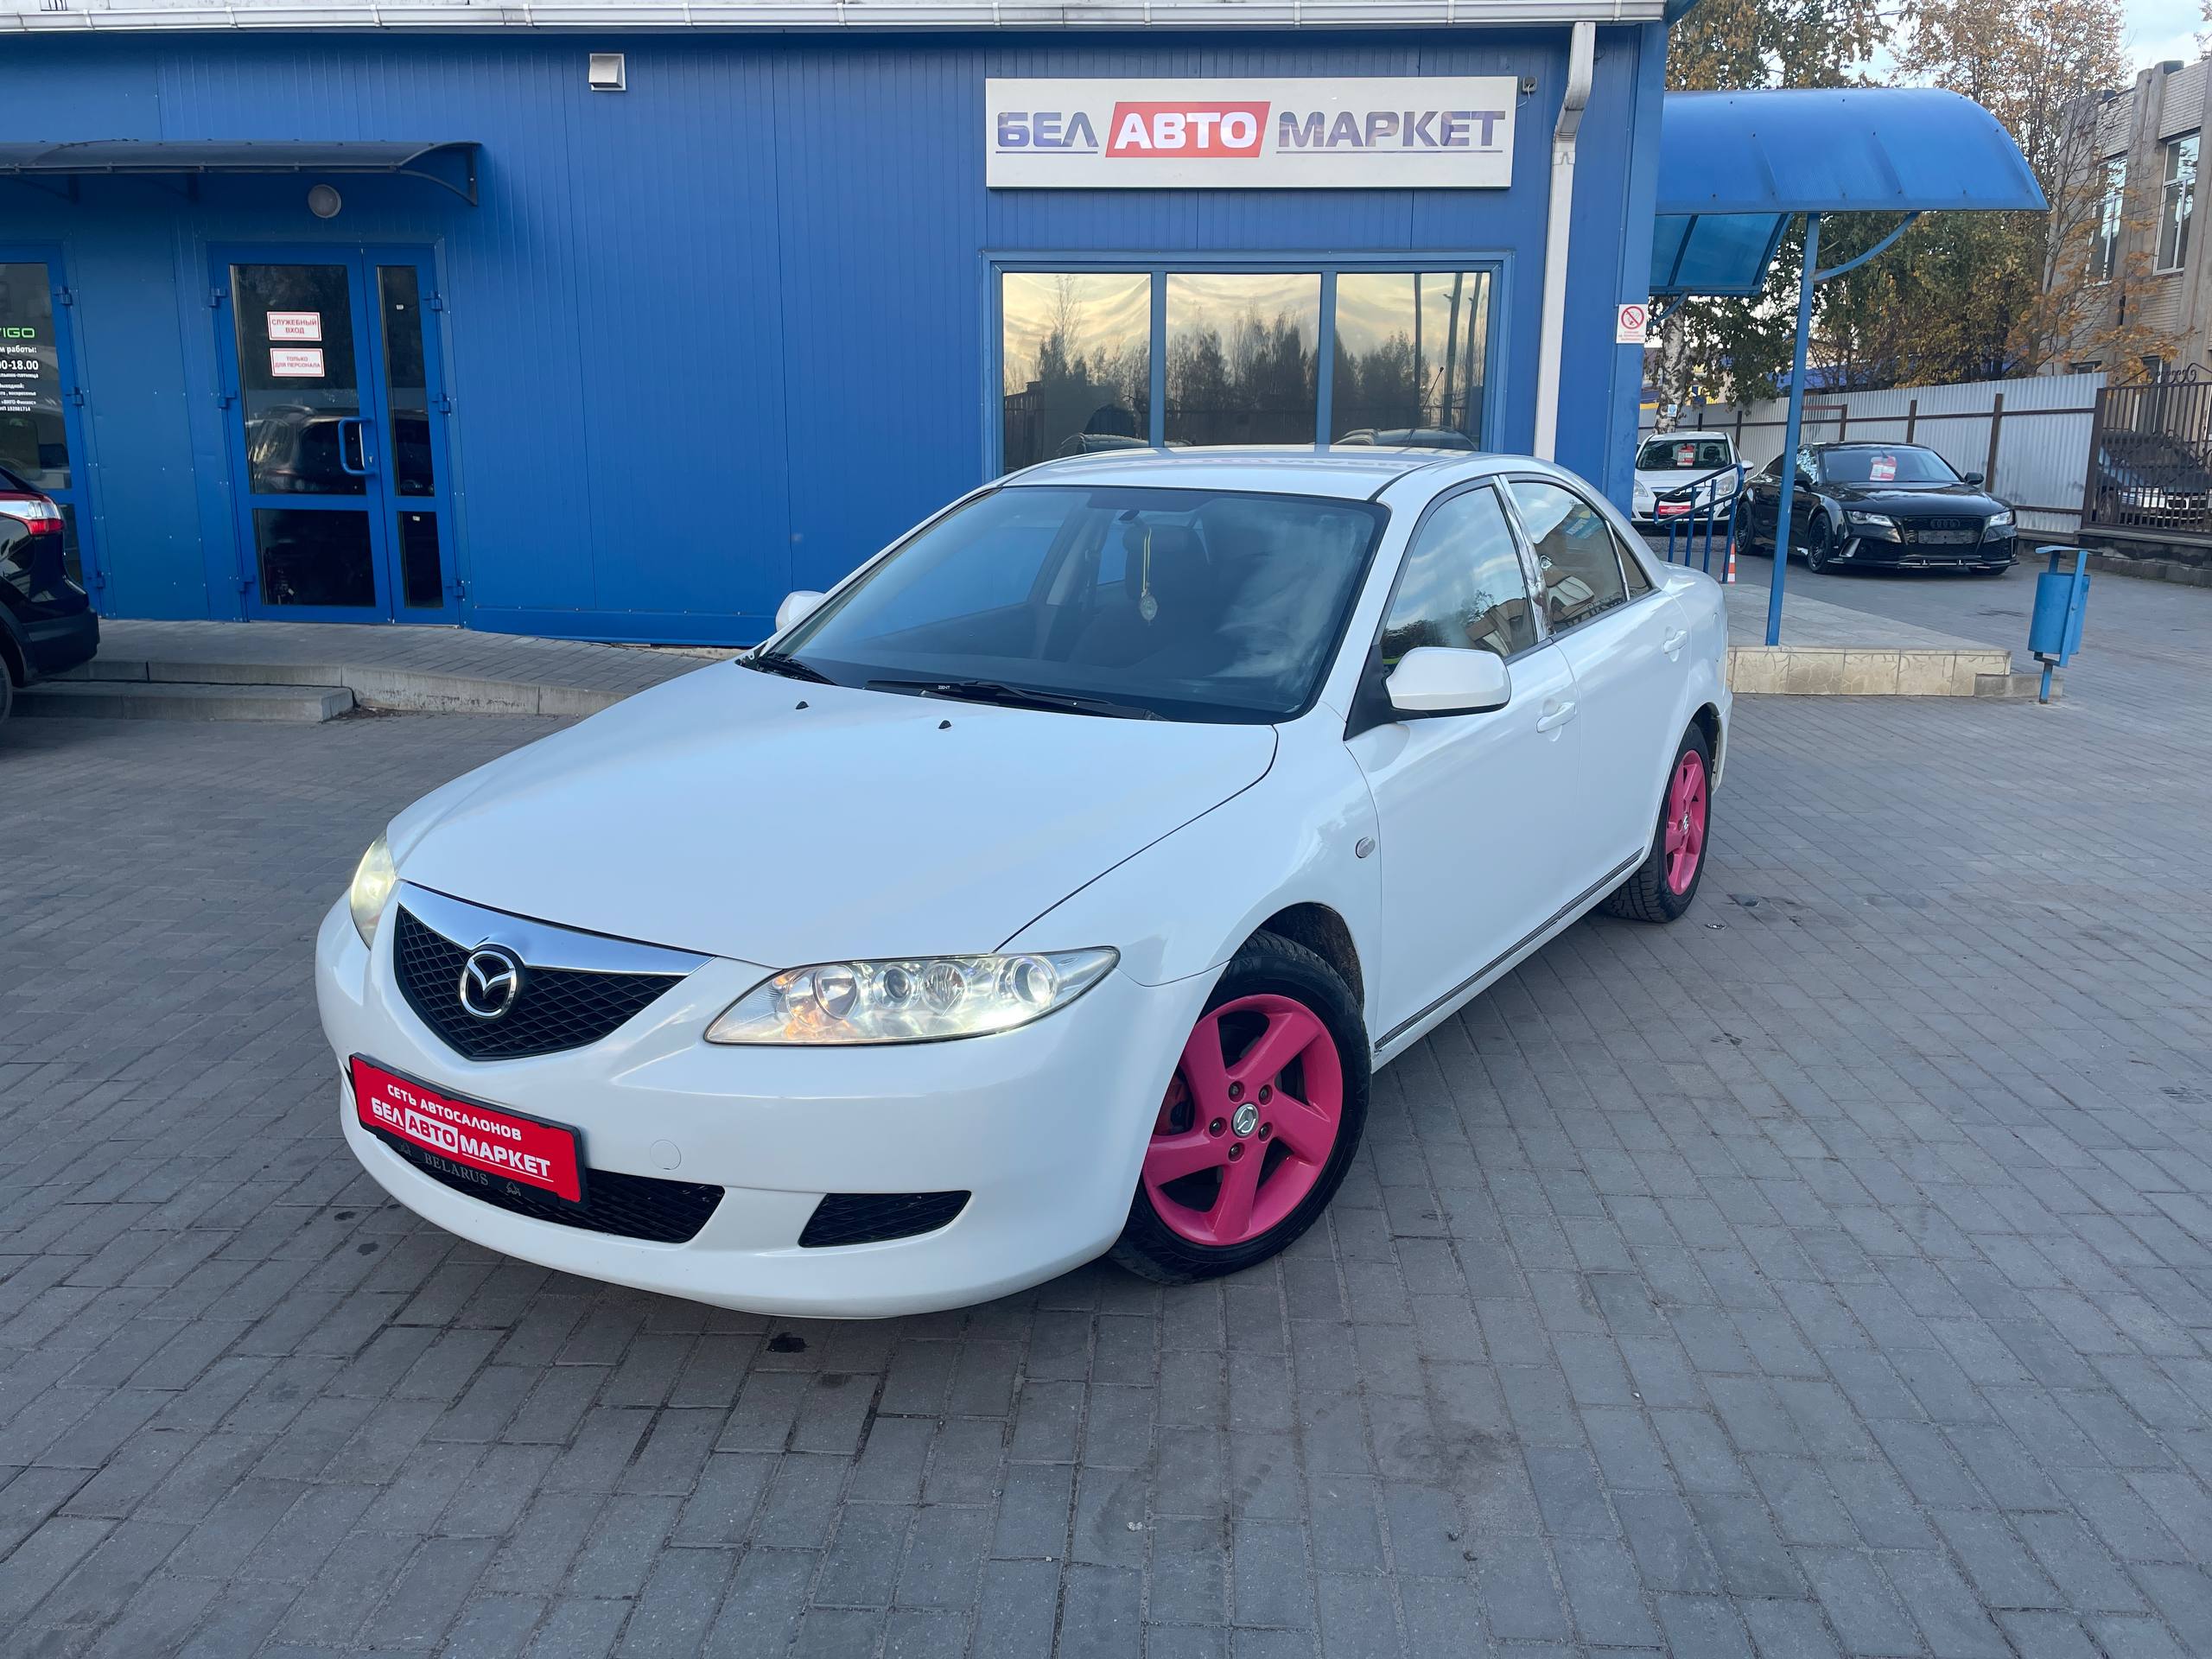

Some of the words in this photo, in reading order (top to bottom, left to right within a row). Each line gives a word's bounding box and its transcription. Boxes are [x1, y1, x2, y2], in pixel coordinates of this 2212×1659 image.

[997, 111, 1099, 148] БЕЛ
[1114, 111, 1257, 149] АВТО
[1279, 111, 1506, 148] МАРКЕТ
[0, 327, 35, 338] IGO
[6, 345, 37, 354] работы:
[0, 359, 39, 370] 0-18.00
[387, 1084, 417, 1106] СЕТЬ
[420, 1098, 522, 1141] АВТОСАЛОНОВ
[371, 1096, 404, 1128] БЕЛ
[408, 1115, 456, 1147] АВТО
[460, 1135, 550, 1177] МАРКЕТ
[423, 1151, 489, 1185] BELARUS
